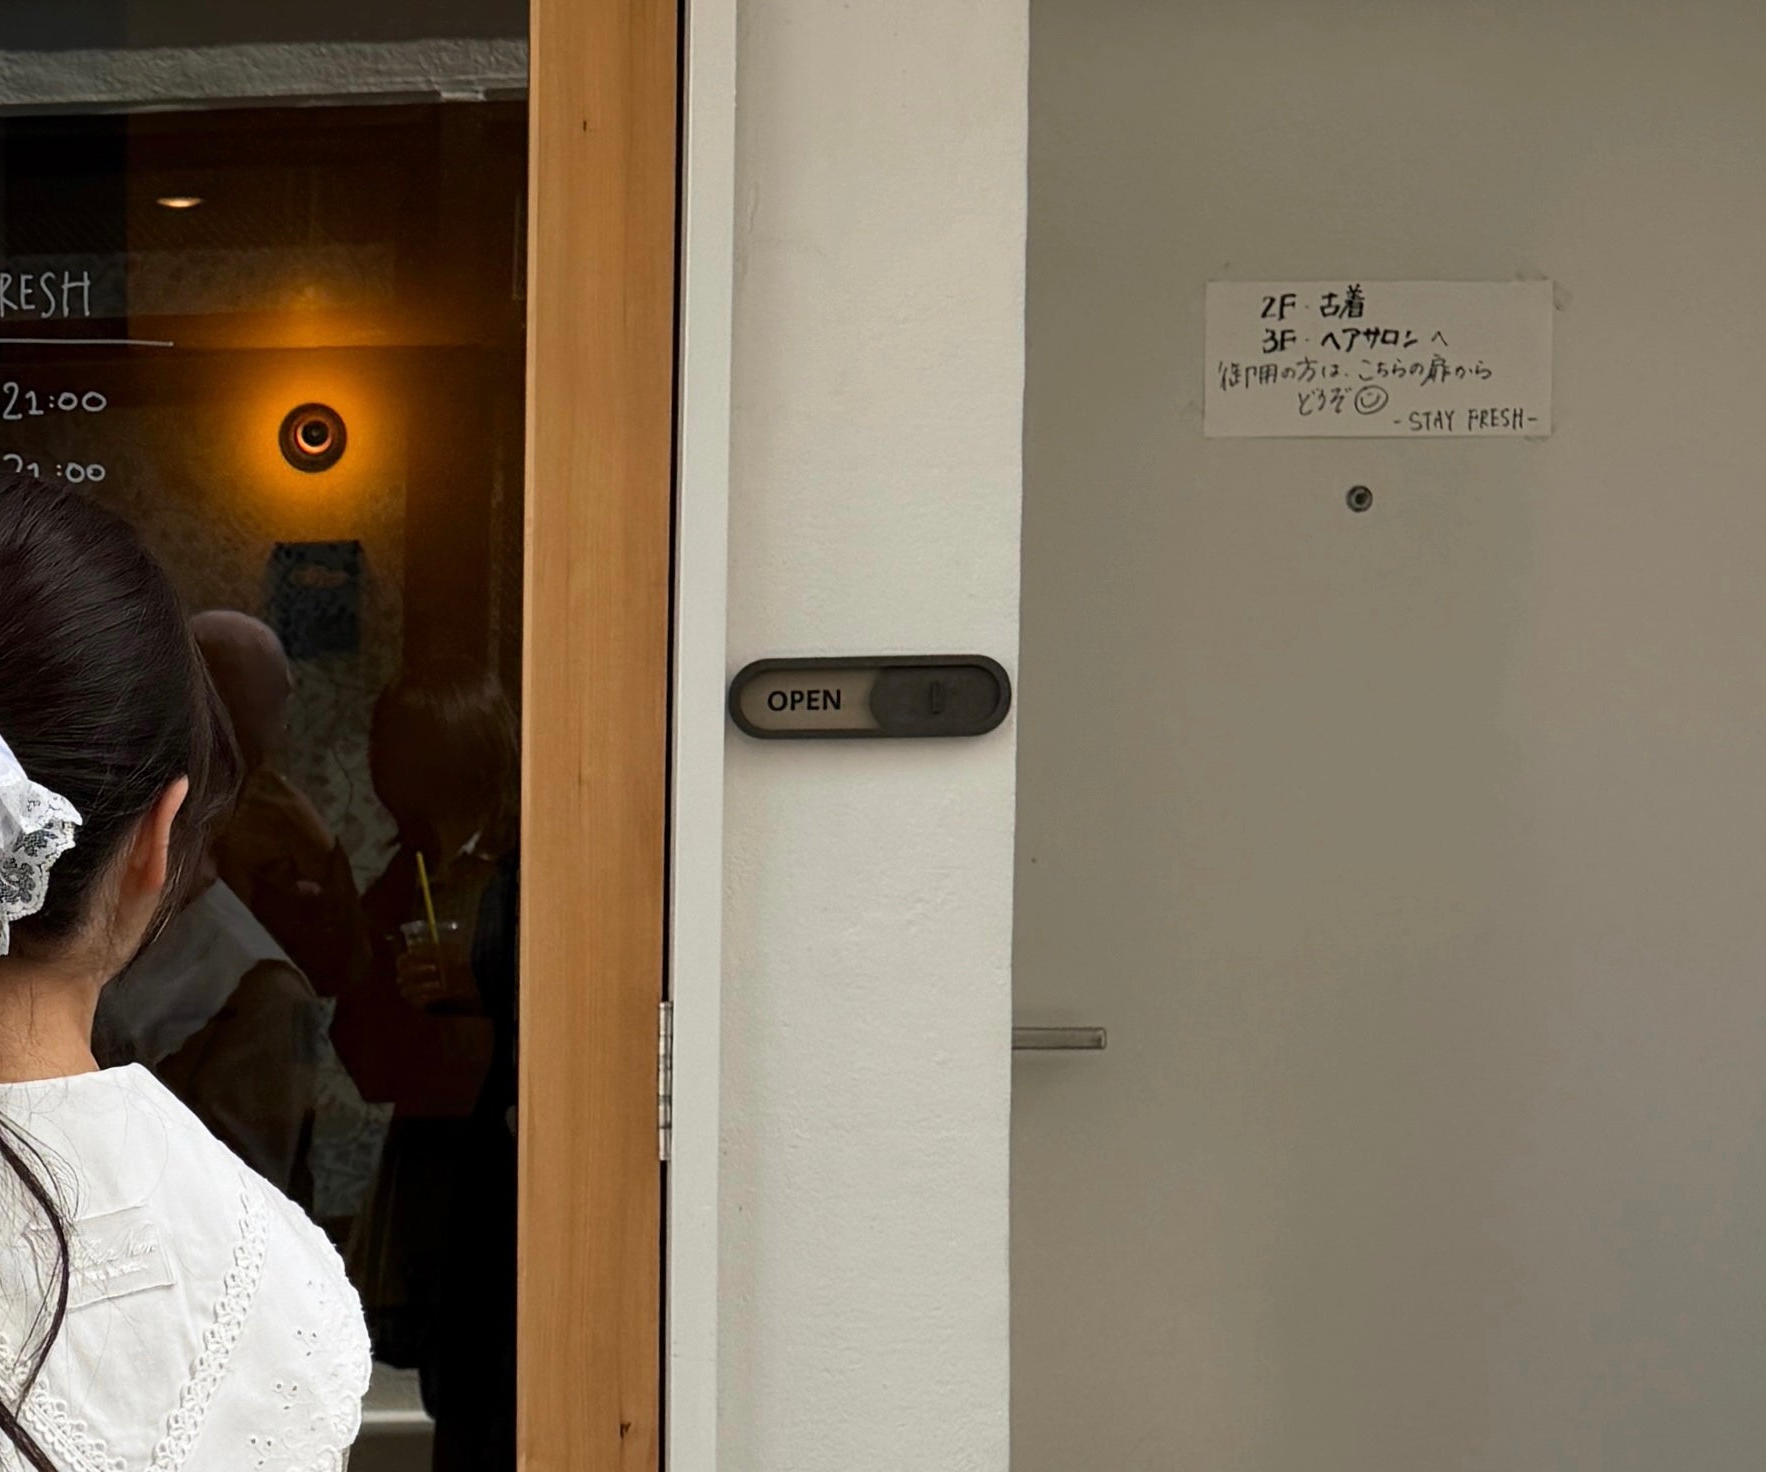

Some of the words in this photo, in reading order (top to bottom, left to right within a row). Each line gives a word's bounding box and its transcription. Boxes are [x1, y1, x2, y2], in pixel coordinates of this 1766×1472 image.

[1260, 293, 1297, 322] 2F
[1319, 283, 1365, 319] 古着
[1262, 329, 1297, 353] 3F
[2, 382, 107, 420] 21:00
[766, 688, 842, 712] OPEN
